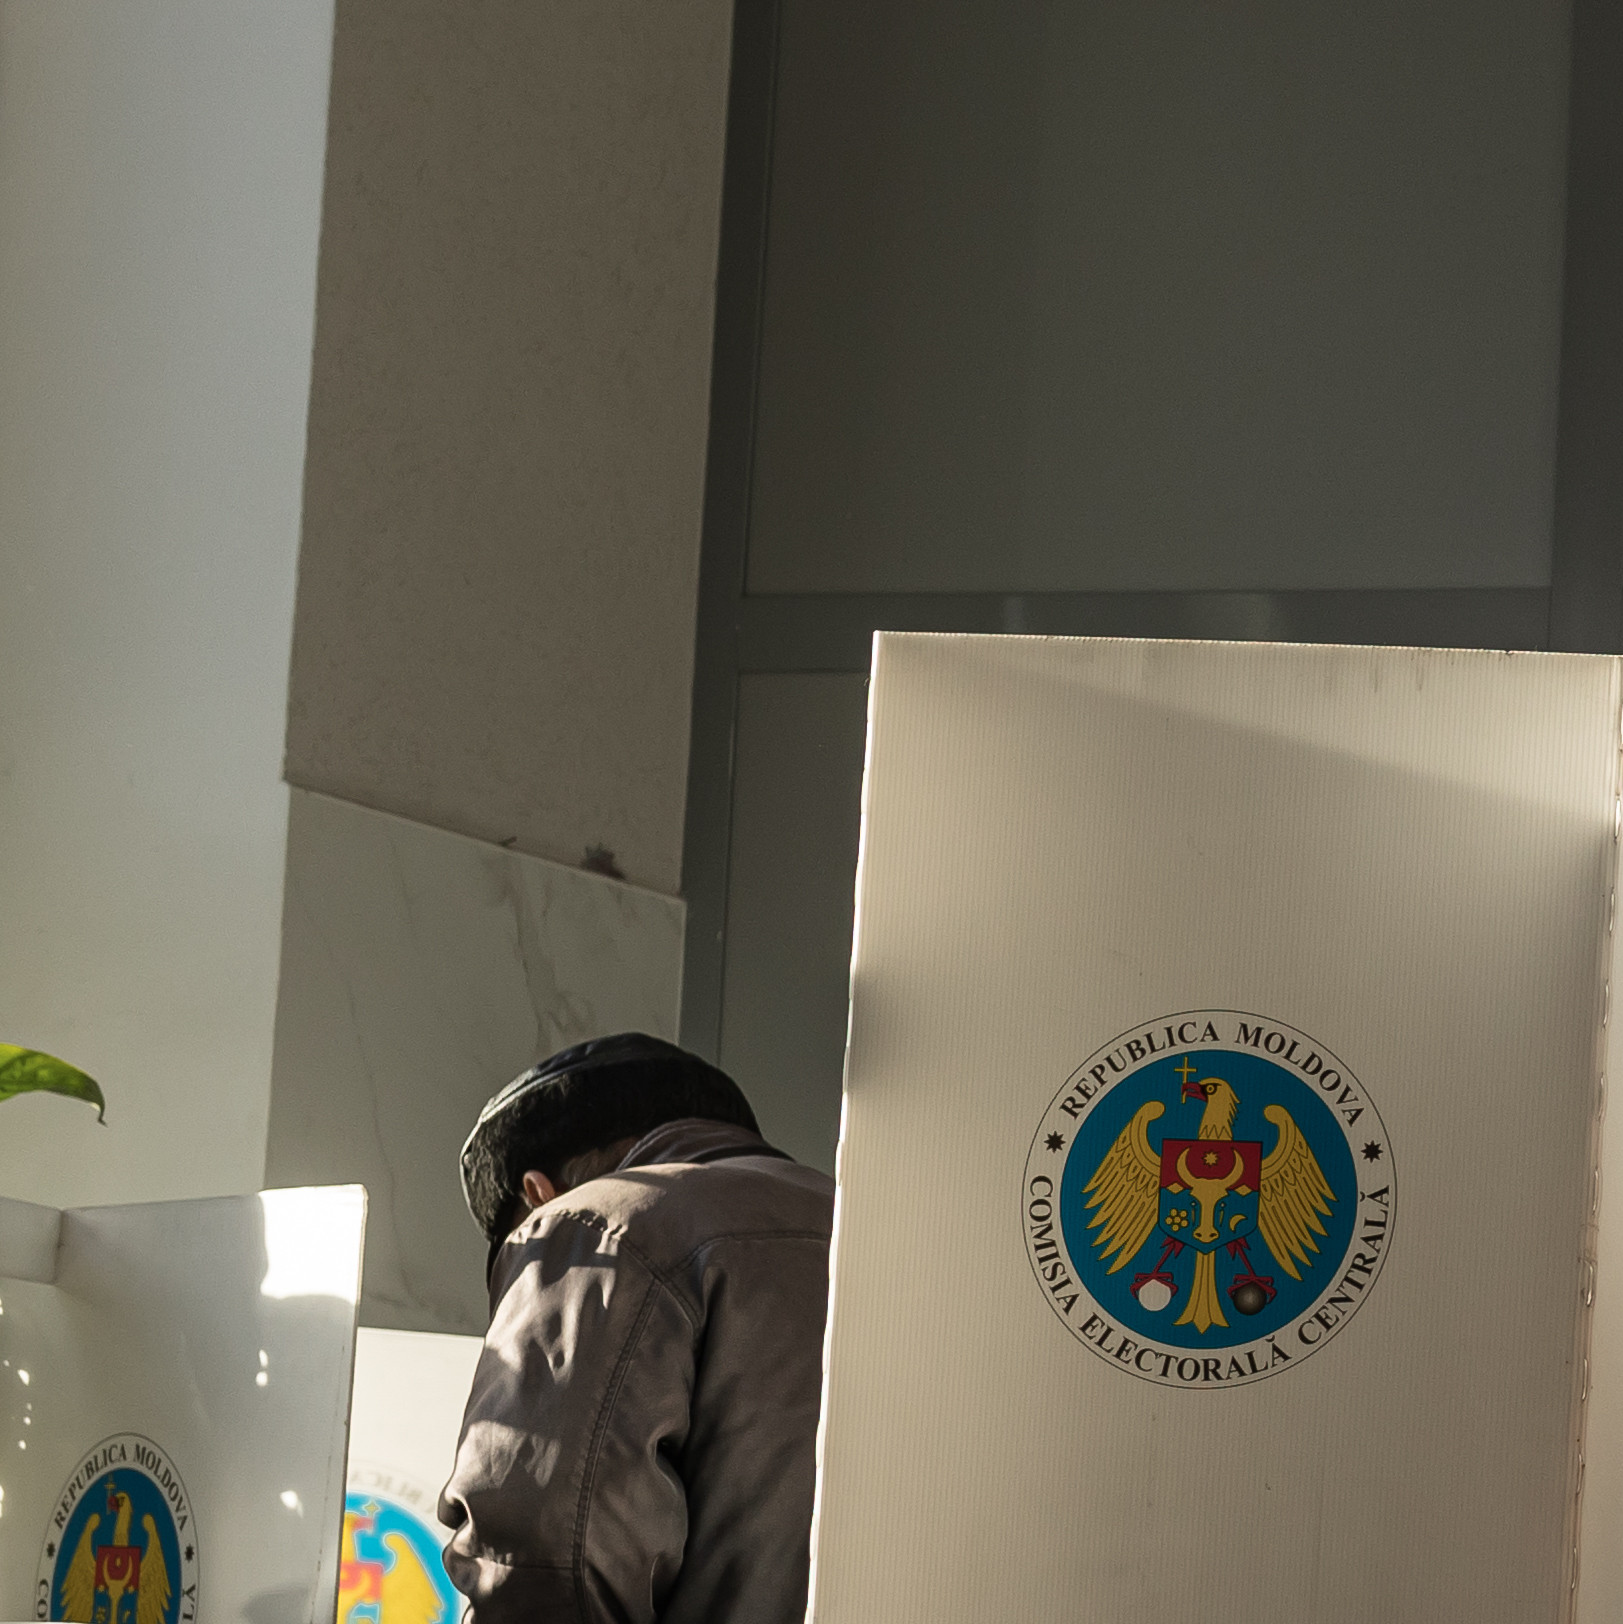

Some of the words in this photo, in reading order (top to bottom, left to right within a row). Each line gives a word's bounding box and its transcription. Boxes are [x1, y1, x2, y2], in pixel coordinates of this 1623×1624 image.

[1058, 1020, 1220, 1120] REPUBLICA
[1234, 1022, 1366, 1128] MOLDOVA
[1028, 1174, 1083, 1316] COMISIA
[1078, 1311, 1292, 1383] ELECTORALĂ
[1296, 1184, 1391, 1346] CENTRALĂ
[54, 1443, 128, 1531] REPUBLICA
[132, 1442, 189, 1532] MOLDOVA
